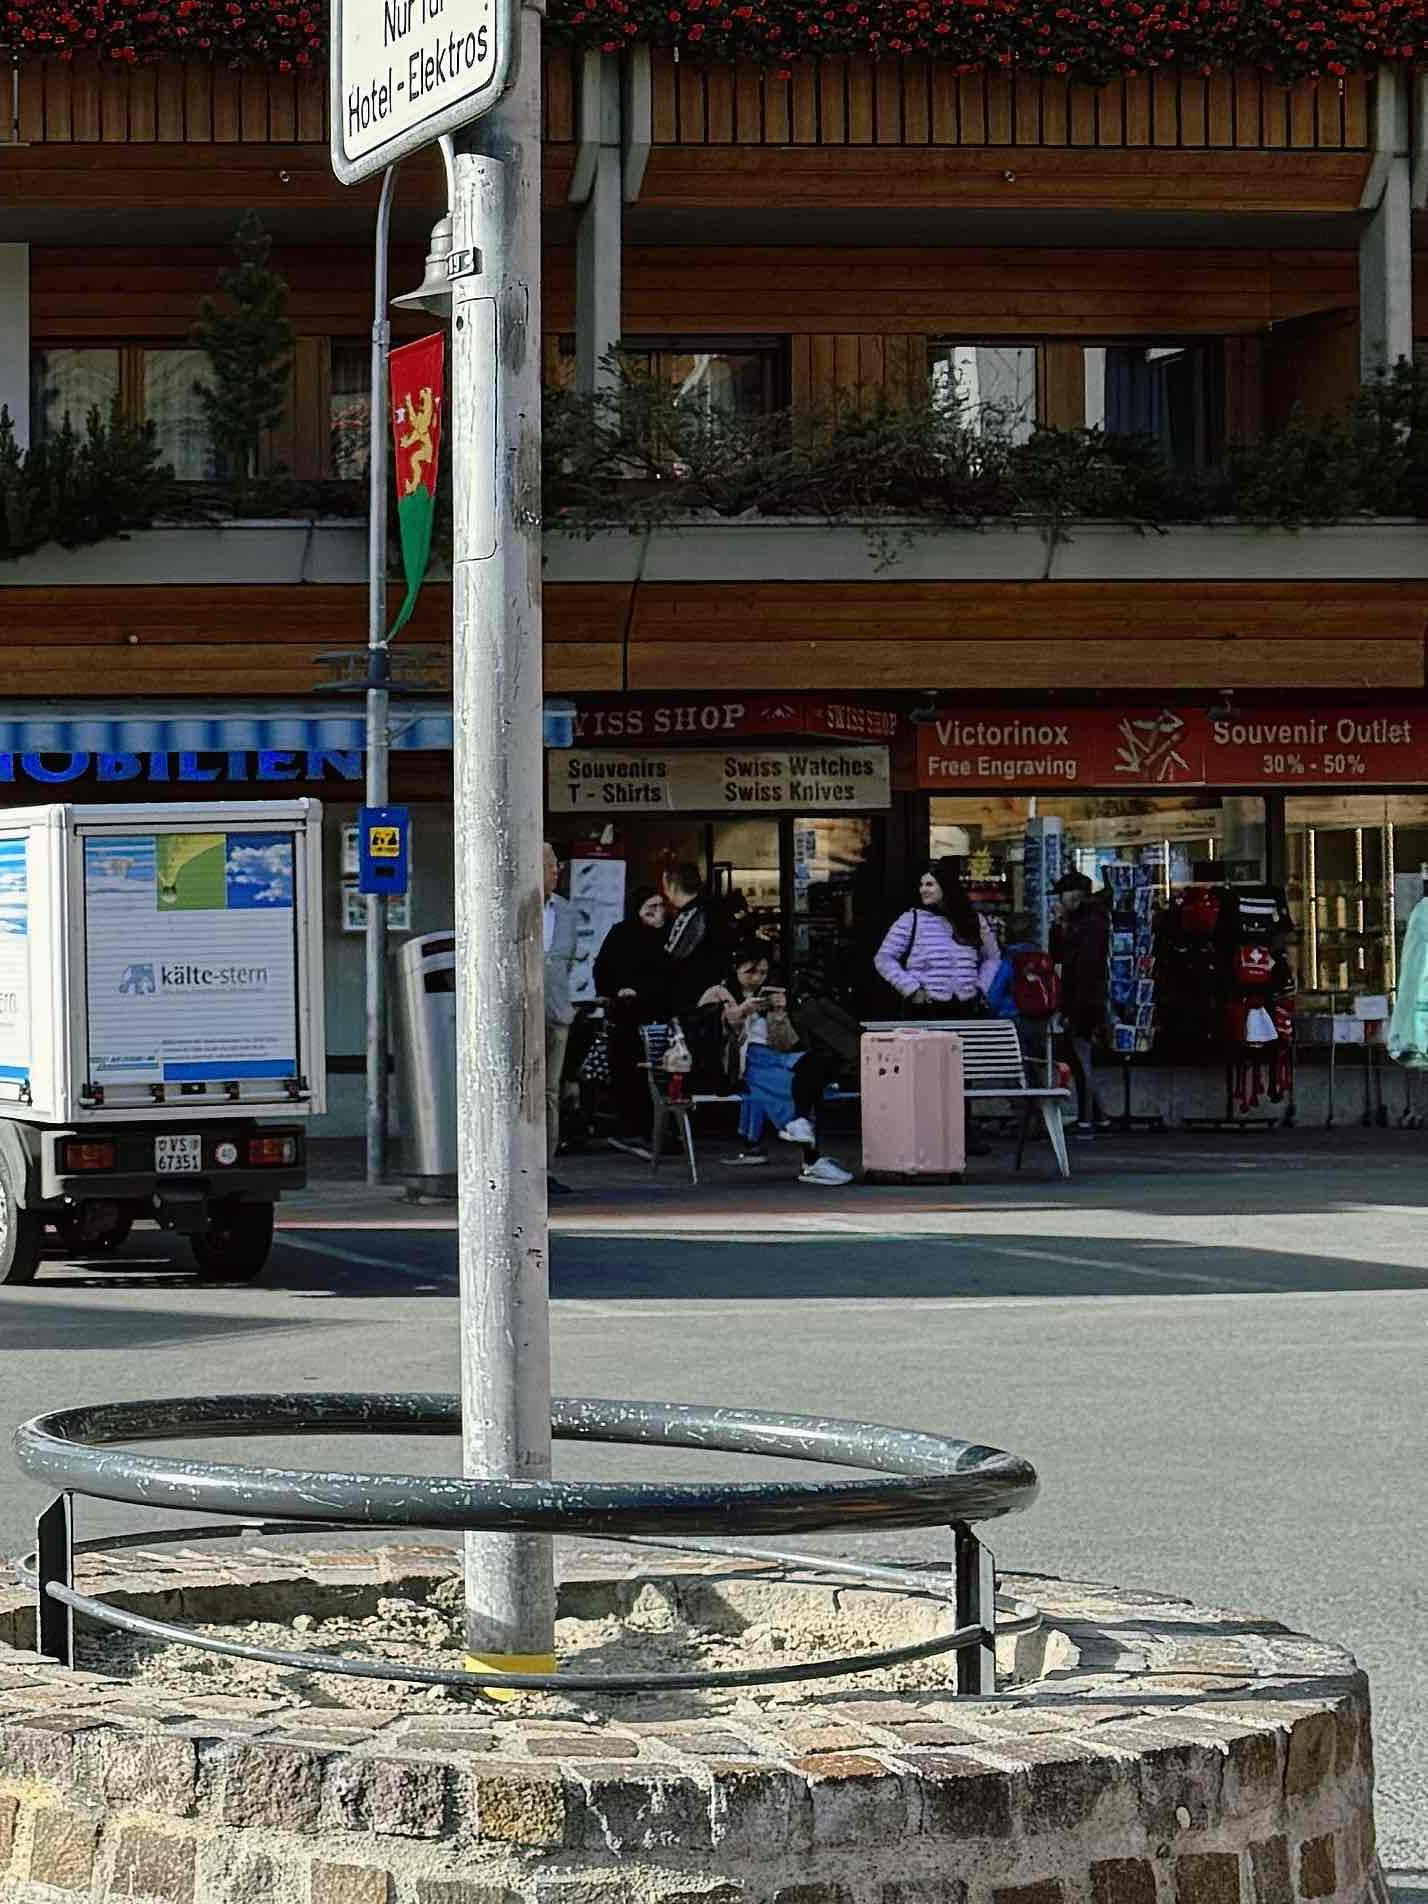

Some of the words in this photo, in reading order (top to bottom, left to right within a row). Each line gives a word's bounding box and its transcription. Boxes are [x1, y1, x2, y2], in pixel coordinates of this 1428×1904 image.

[348, 67, 392, 136] Hotel
[409, 24, 488, 102] Elektros
[654, 703, 745, 734] SHOP
[935, 720, 1069, 745] Victorinox
[1213, 721, 1329, 744] Souvenir
[1336, 719, 1412, 744] Outlet
[567, 759, 666, 779] Souvenirs
[724, 757, 782, 778] Swiss
[790, 756, 874, 778] Watches
[927, 756, 971, 776] Free
[977, 756, 1077, 780] Engraving
[602, 783, 662, 804] Shirts
[724, 783, 782, 803] Swiss
[790, 783, 856, 803] Knives
[160, 964, 268, 985] kälte-stern
[170, 1138, 187, 1152] VS
[158, 1155, 199, 1170] 67351
